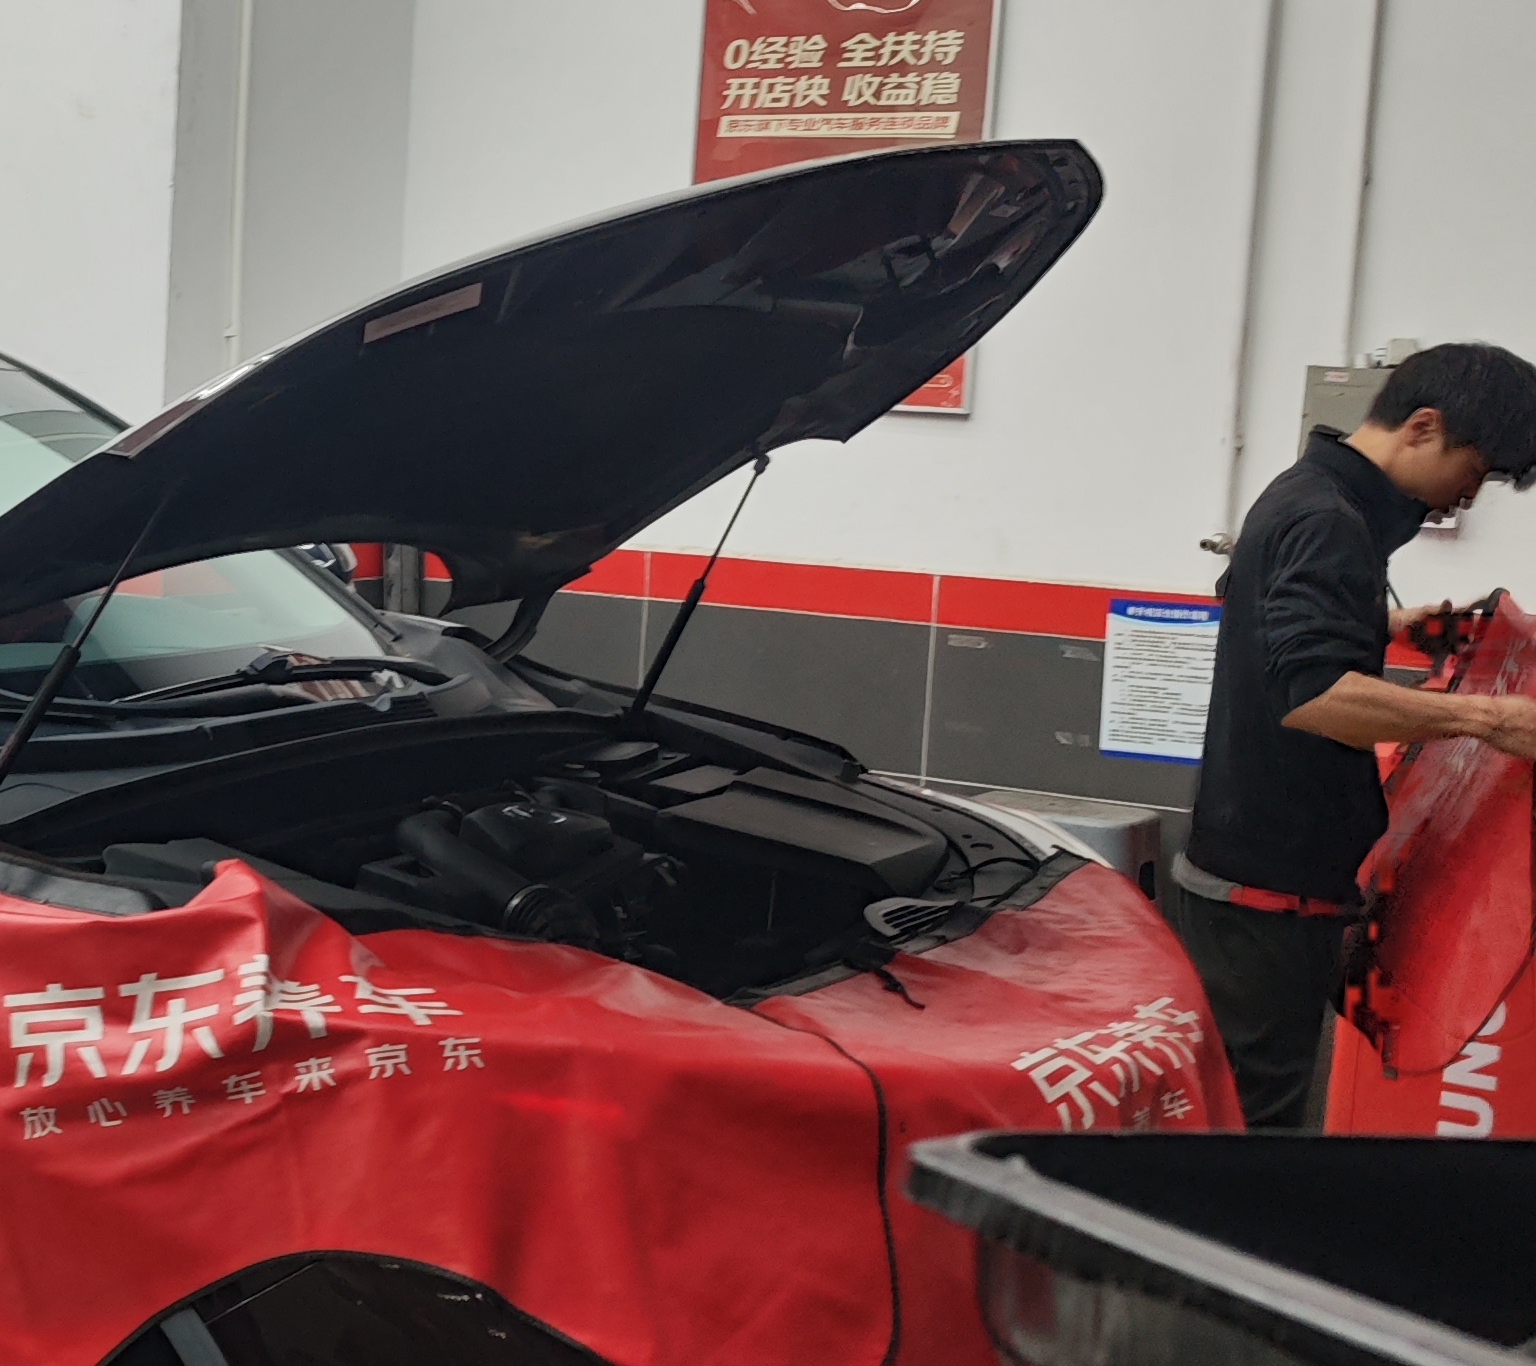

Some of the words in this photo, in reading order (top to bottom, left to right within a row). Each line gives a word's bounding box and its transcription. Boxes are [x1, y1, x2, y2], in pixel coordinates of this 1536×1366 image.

[723, 33, 829, 70] 0经验
[836, 29, 965, 68] 全扶持
[720, 75, 831, 109] 开店快
[840, 72, 961, 107] 收益稳
[4, 953, 463, 1088] 京东养车
[20, 1036, 485, 1140] 放心养车来京东
